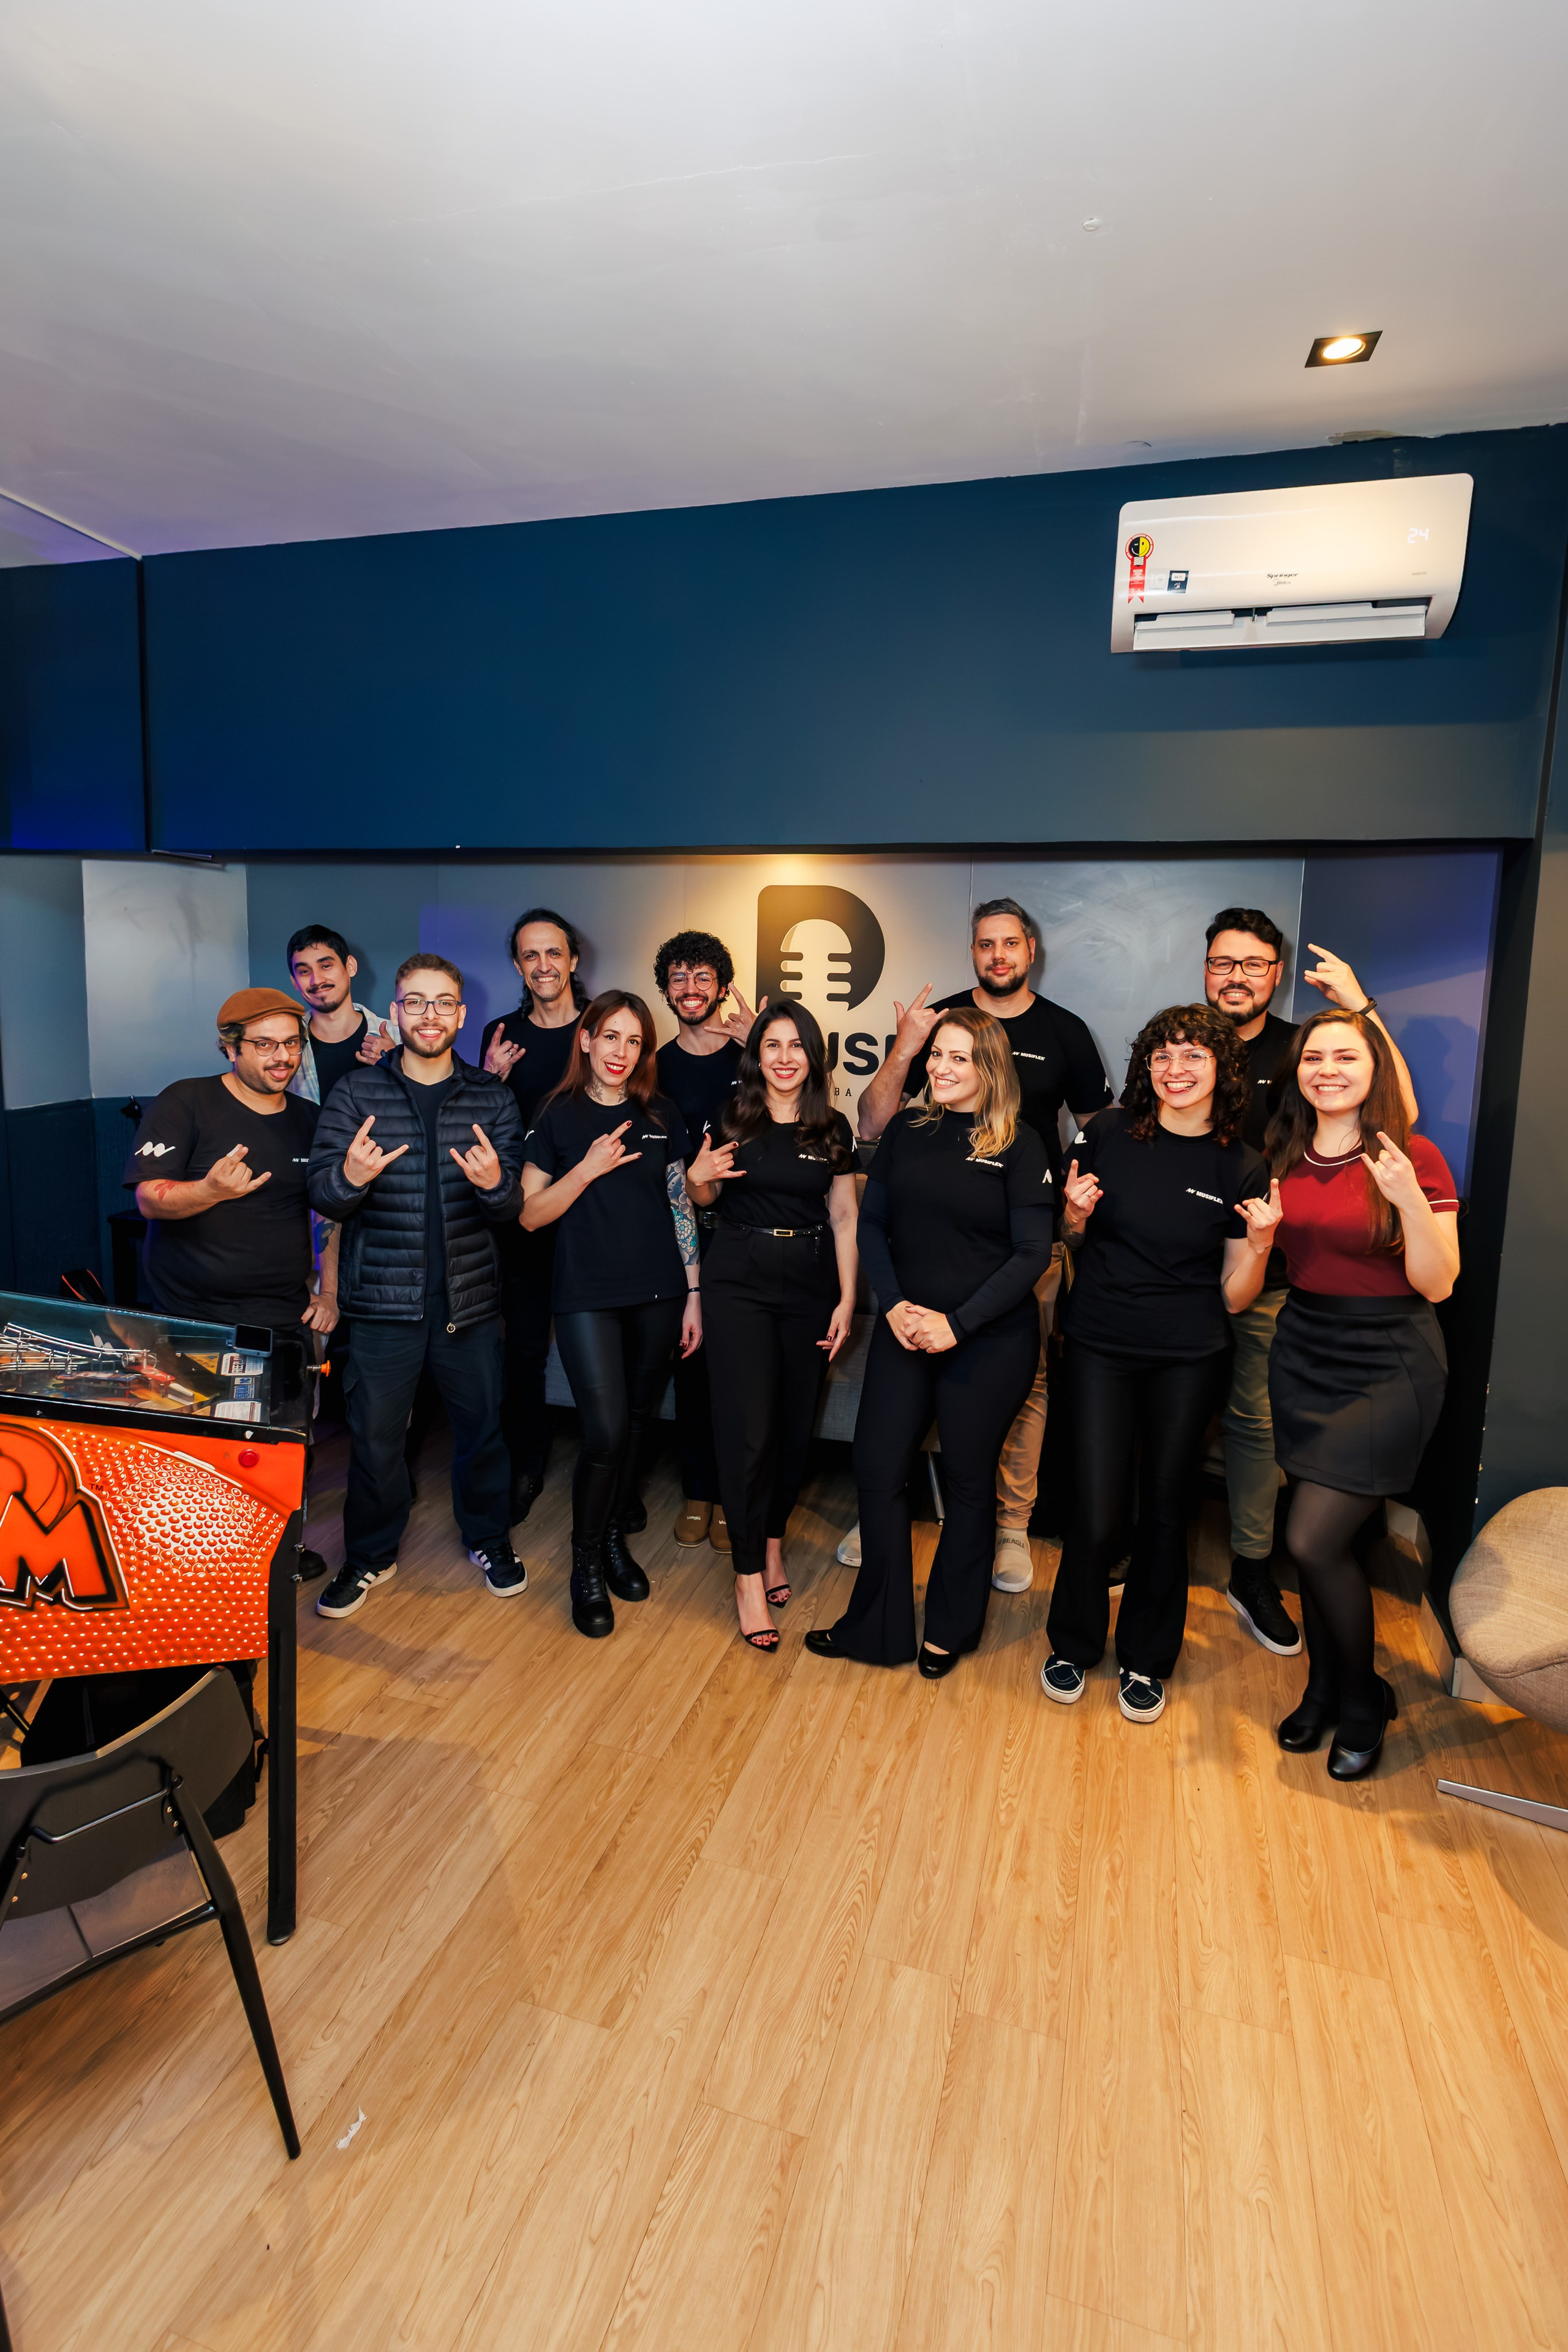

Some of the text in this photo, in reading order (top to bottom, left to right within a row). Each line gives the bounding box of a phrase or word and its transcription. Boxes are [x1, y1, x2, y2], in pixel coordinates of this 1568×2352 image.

[1408, 527, 1430, 544] 24
[1020, 1052, 1046, 1061] MUSIFLEX
[89, 1483, 104, 1491] TM
